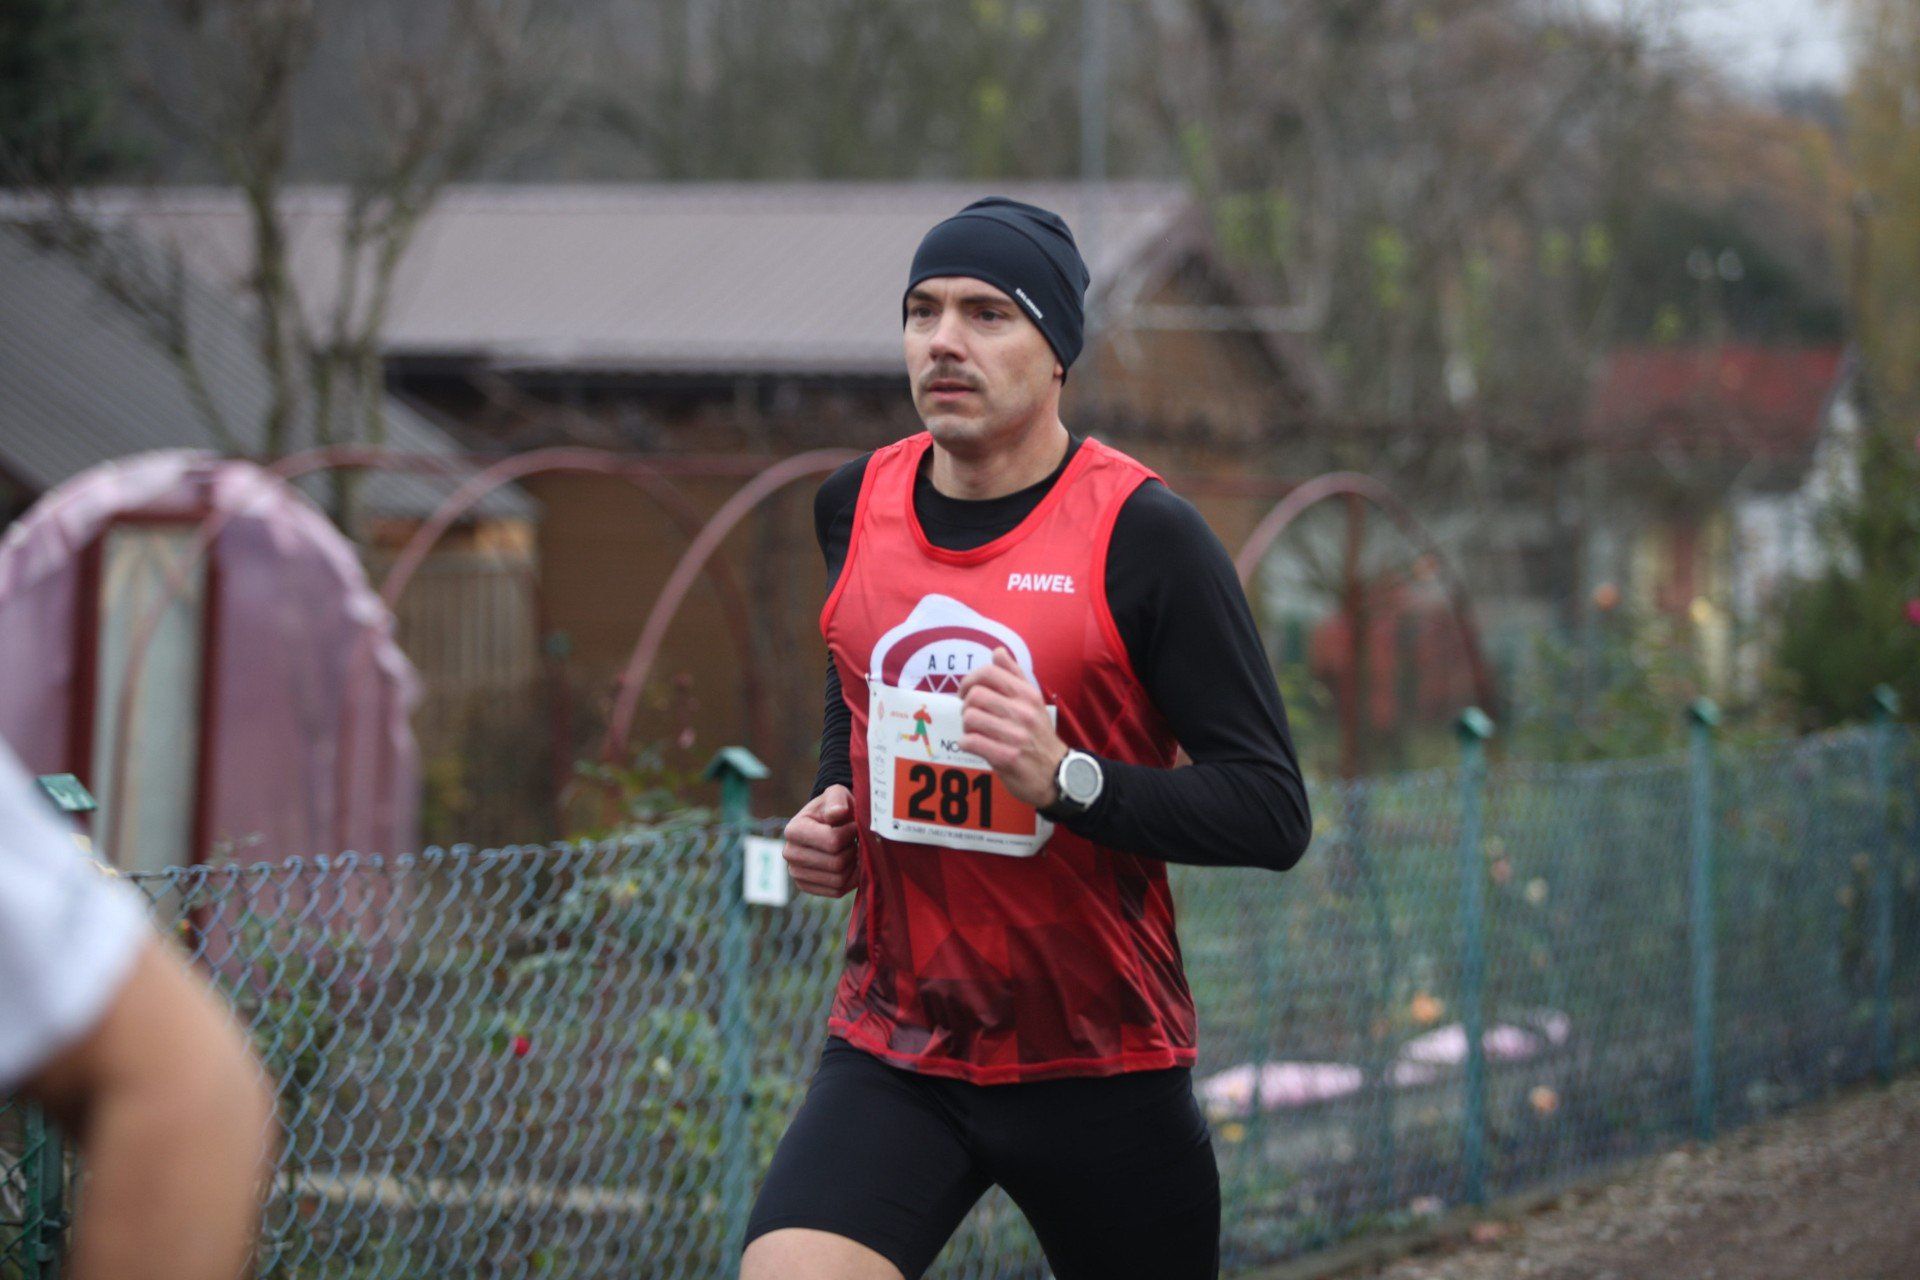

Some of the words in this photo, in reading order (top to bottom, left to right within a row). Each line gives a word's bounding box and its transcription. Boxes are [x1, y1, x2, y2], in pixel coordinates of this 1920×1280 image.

[1007, 573, 1076, 594] PAWEŁ
[928, 654, 975, 670] ACT
[908, 764, 992, 829] 281
